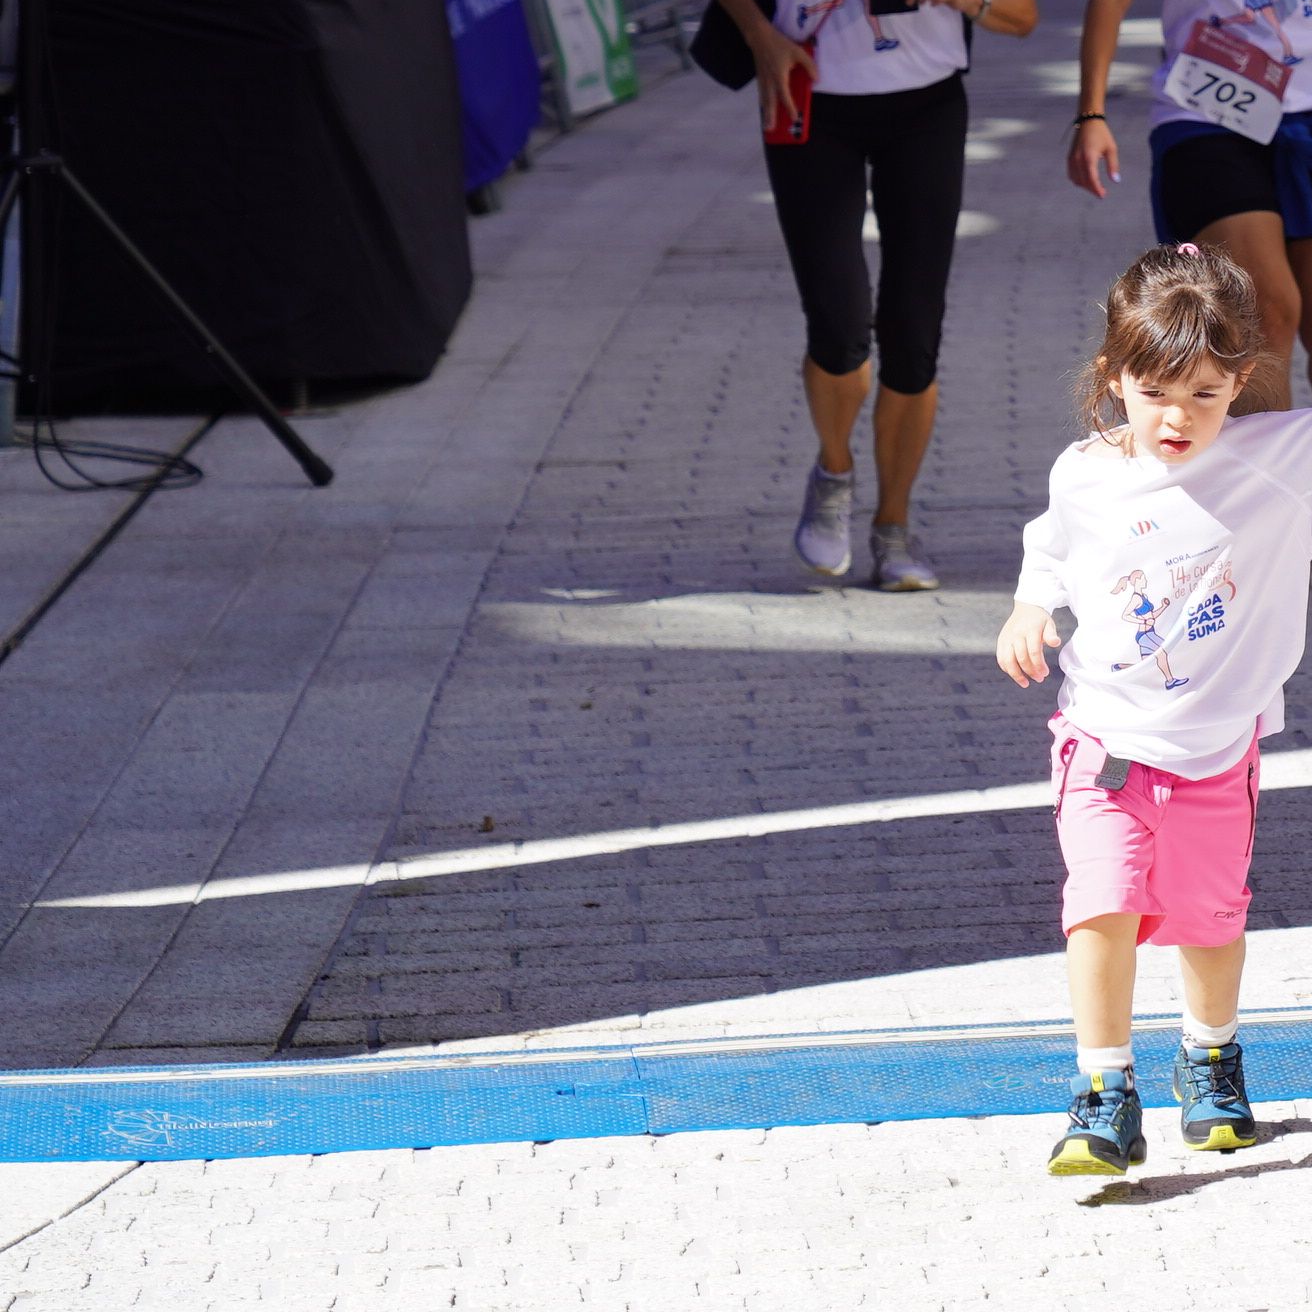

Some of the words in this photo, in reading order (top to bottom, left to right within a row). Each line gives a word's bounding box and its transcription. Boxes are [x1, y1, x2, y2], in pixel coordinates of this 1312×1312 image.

[1193, 72, 1256, 114] 702
[1165, 553, 1192, 567] MORA
[1187, 593, 1222, 617] CADA
[1187, 605, 1225, 630] PAS
[1188, 619, 1226, 642] SUMA
